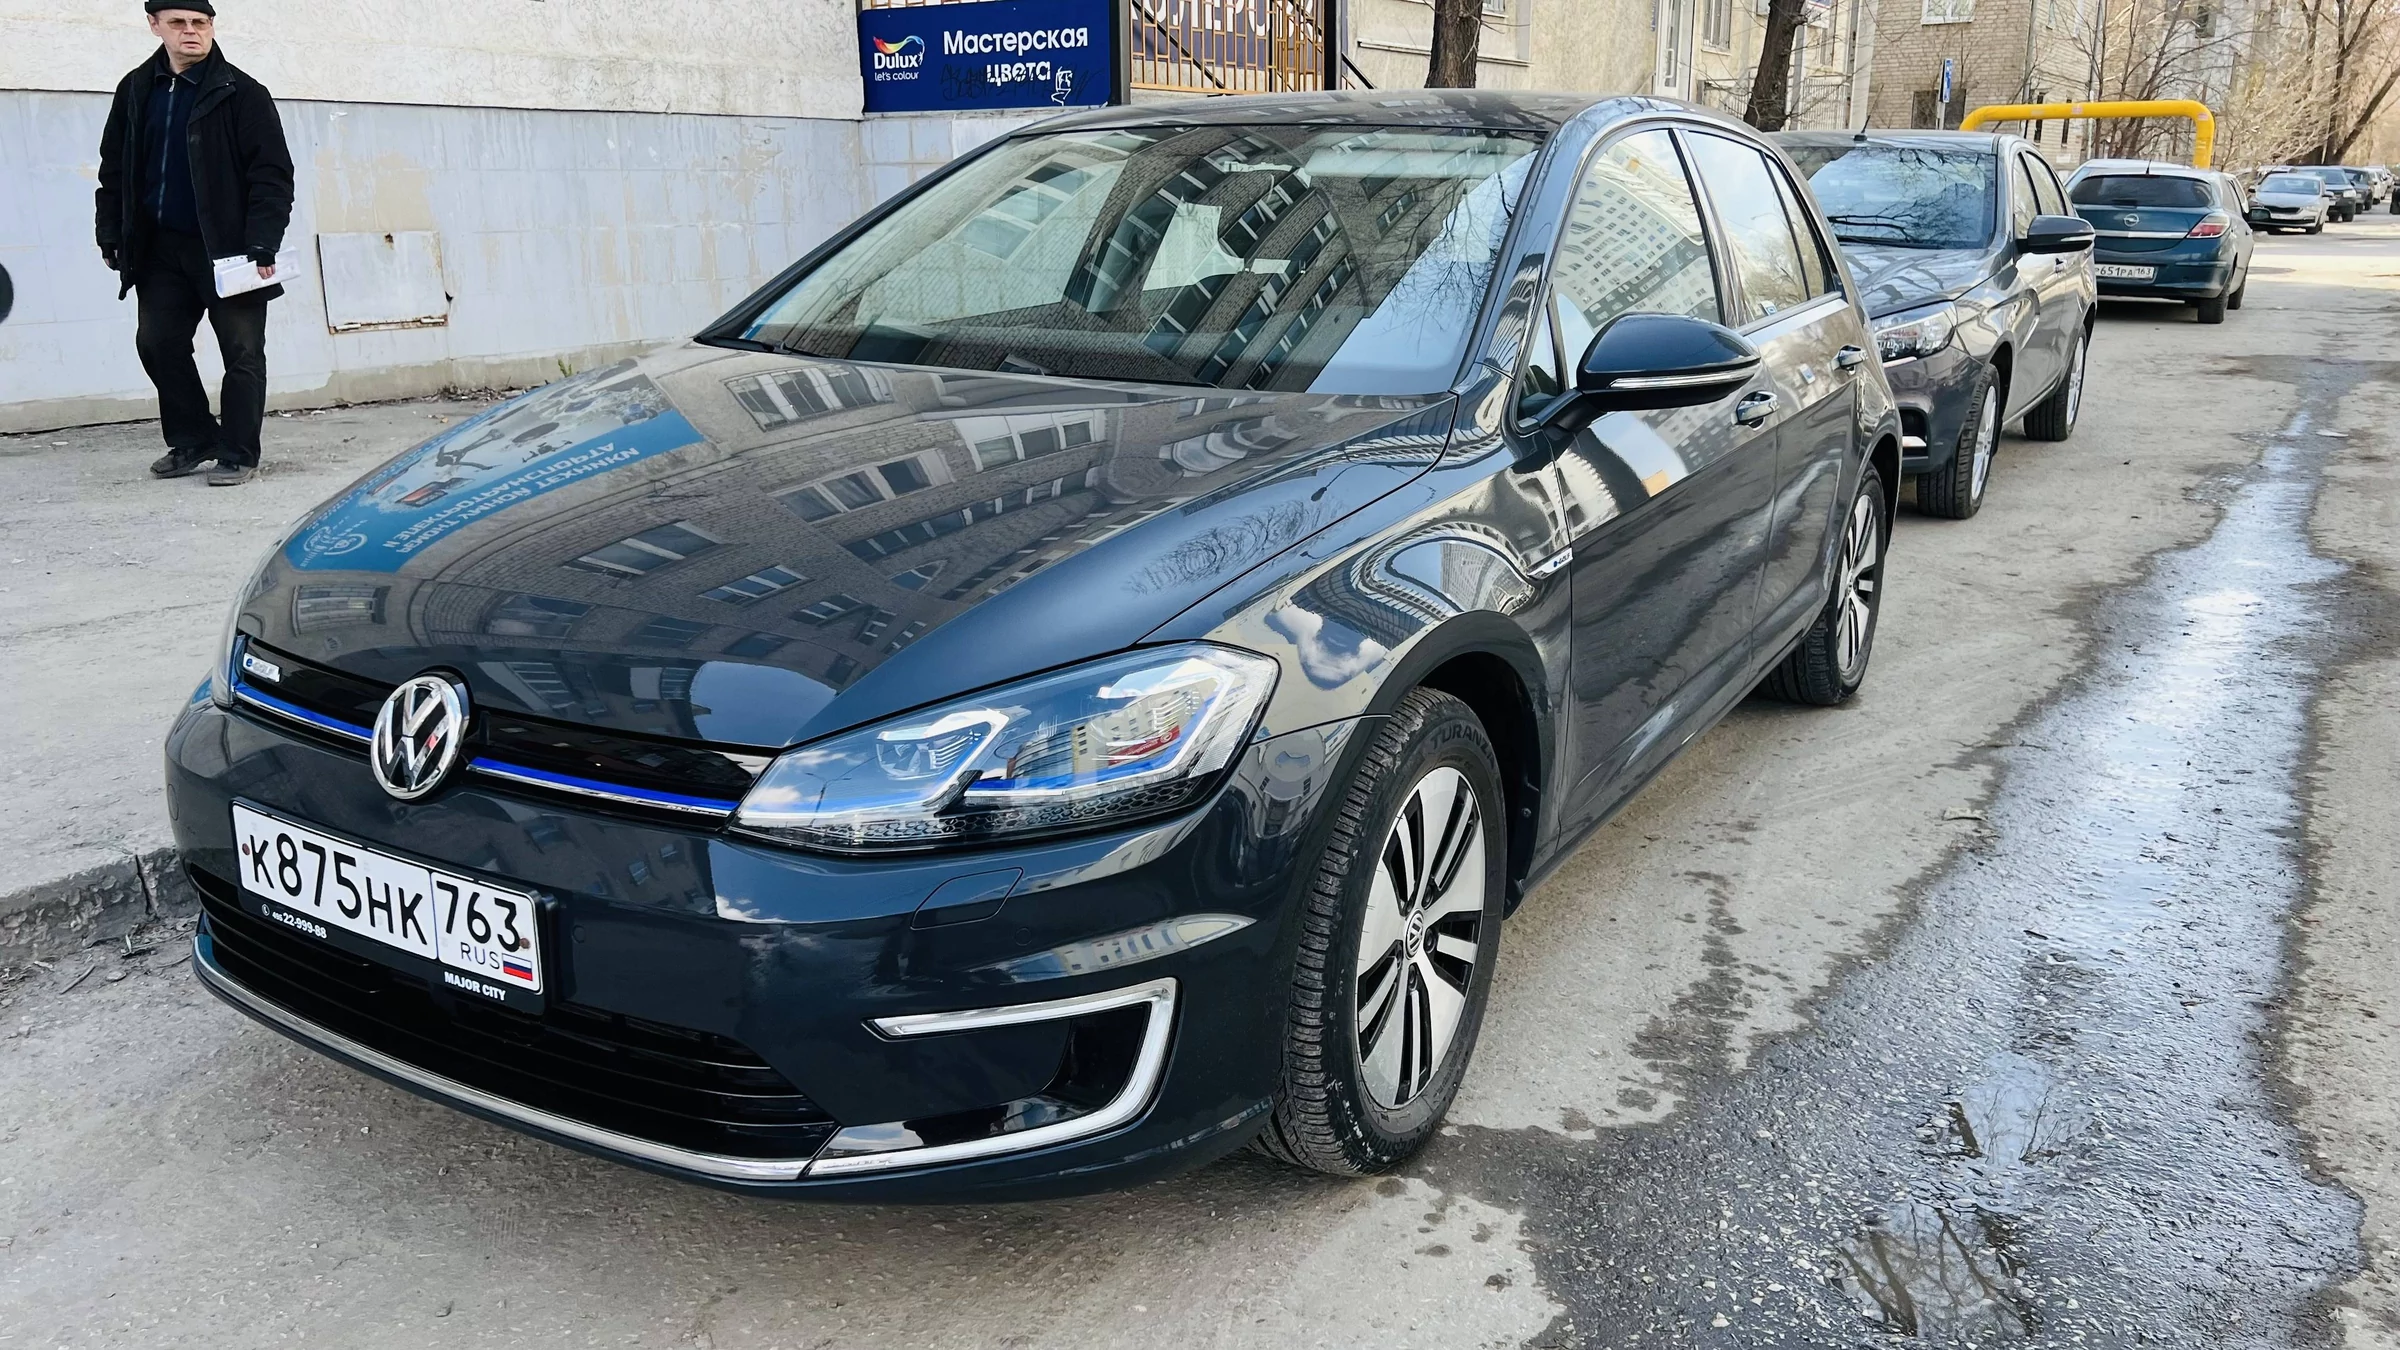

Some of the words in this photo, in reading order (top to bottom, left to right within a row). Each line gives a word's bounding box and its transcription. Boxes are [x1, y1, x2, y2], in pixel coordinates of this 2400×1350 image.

[943, 27, 1088, 56] Мастерская
[874, 52, 919, 69] Dulux
[986, 61, 1051, 86] цвета
[874, 71, 892, 82] let's
[892, 71, 919, 81] colour
[250, 833, 428, 945] К875НК
[436, 881, 521, 952] 763
[283, 912, 327, 938] 22-999-88
[460, 941, 500, 970] RUS
[444, 971, 481, 993] MAJOR
[482, 984, 506, 1001] CITY
